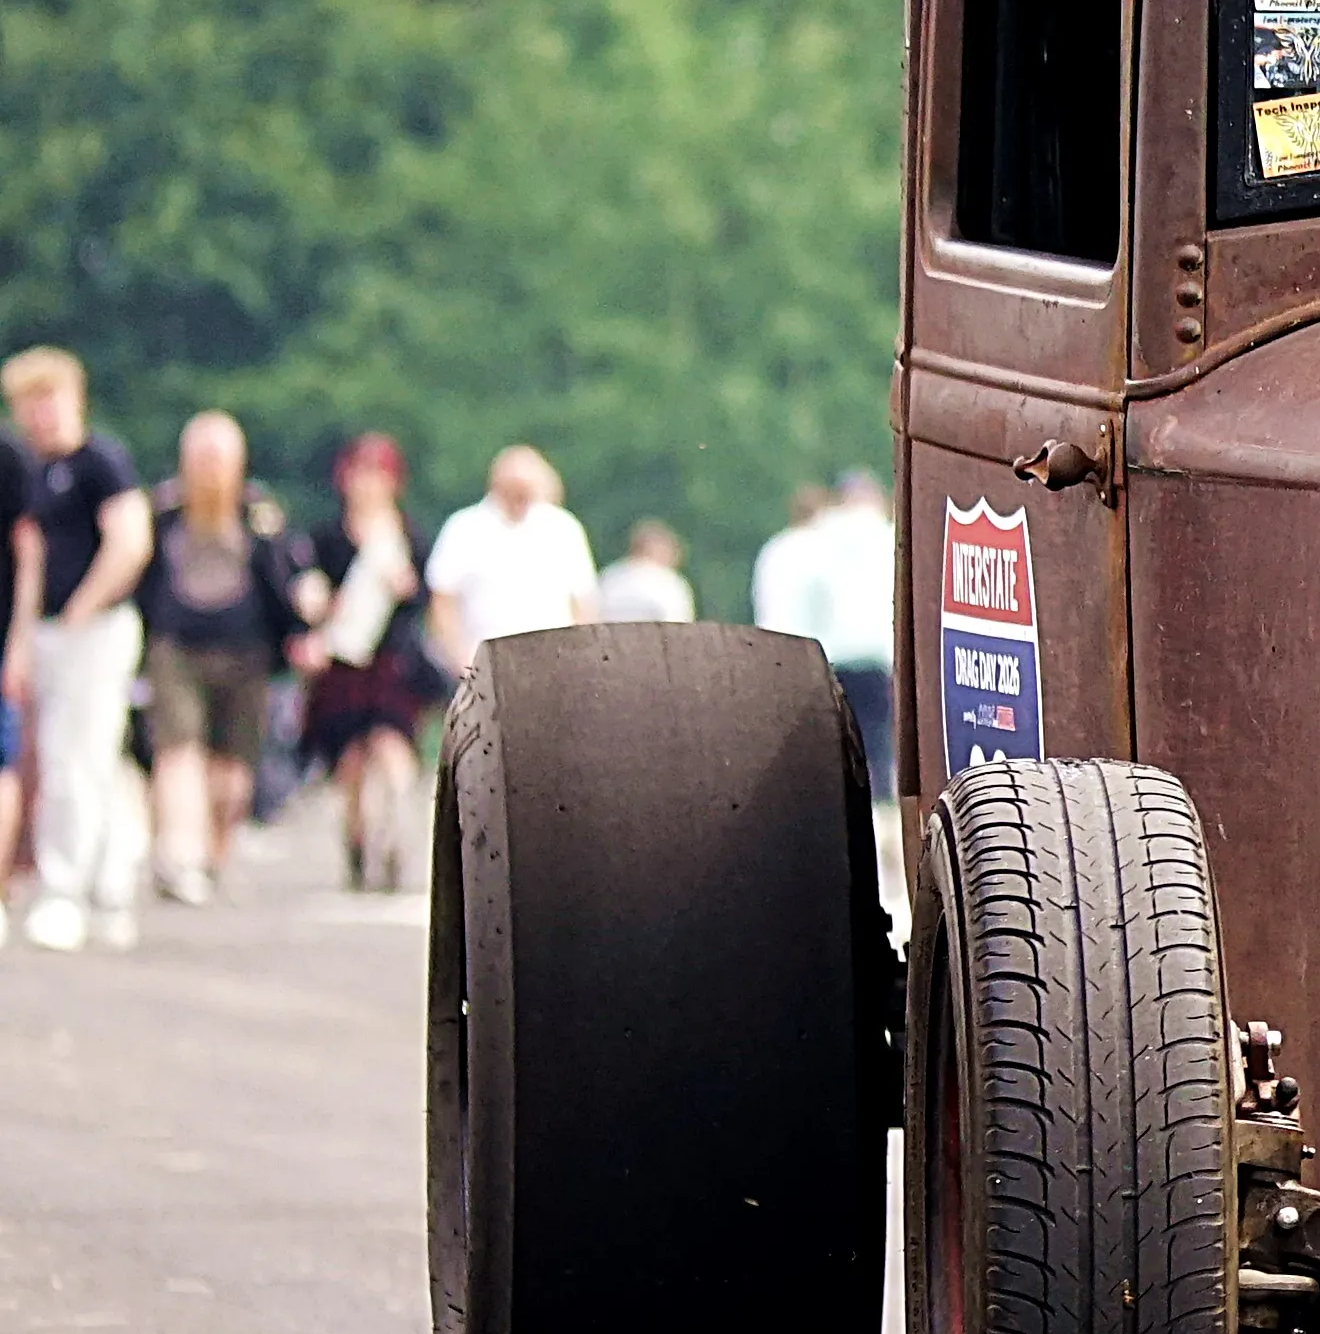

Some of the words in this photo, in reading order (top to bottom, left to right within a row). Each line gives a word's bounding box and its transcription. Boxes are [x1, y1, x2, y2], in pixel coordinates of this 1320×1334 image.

[1256, 105, 1287, 117] Tech
[952, 541, 1018, 612] INTERSTATE
[954, 646, 979, 689] DRAG
[979, 651, 997, 692] DAY
[997, 653, 1020, 696] 2026
